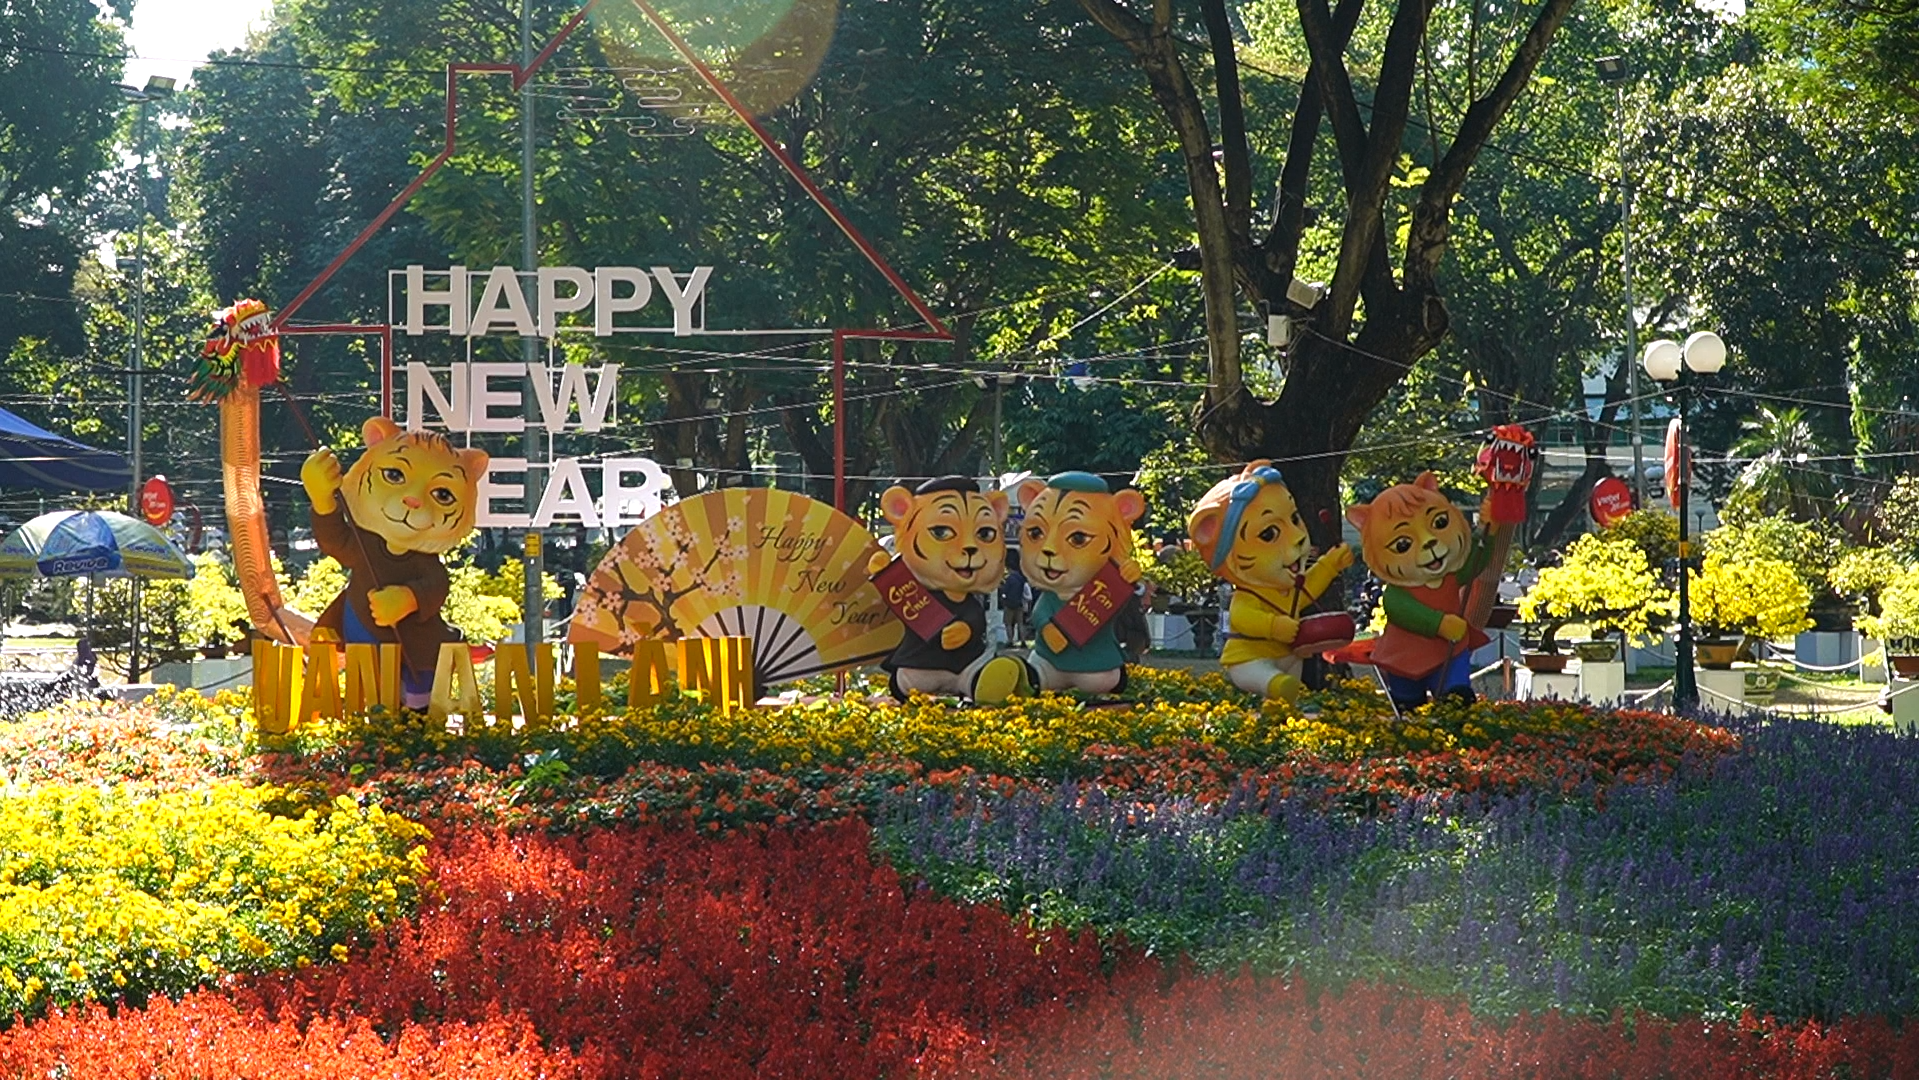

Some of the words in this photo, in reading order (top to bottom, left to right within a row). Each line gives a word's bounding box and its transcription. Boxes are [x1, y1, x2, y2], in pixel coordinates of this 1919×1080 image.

[406, 265, 714, 336] HAPPY
[406, 362, 619, 432] NEW
[475, 457, 662, 528] EAR
[53, 556, 109, 574] Revive
[753, 525, 828, 562] Happy
[789, 568, 846, 593] New
